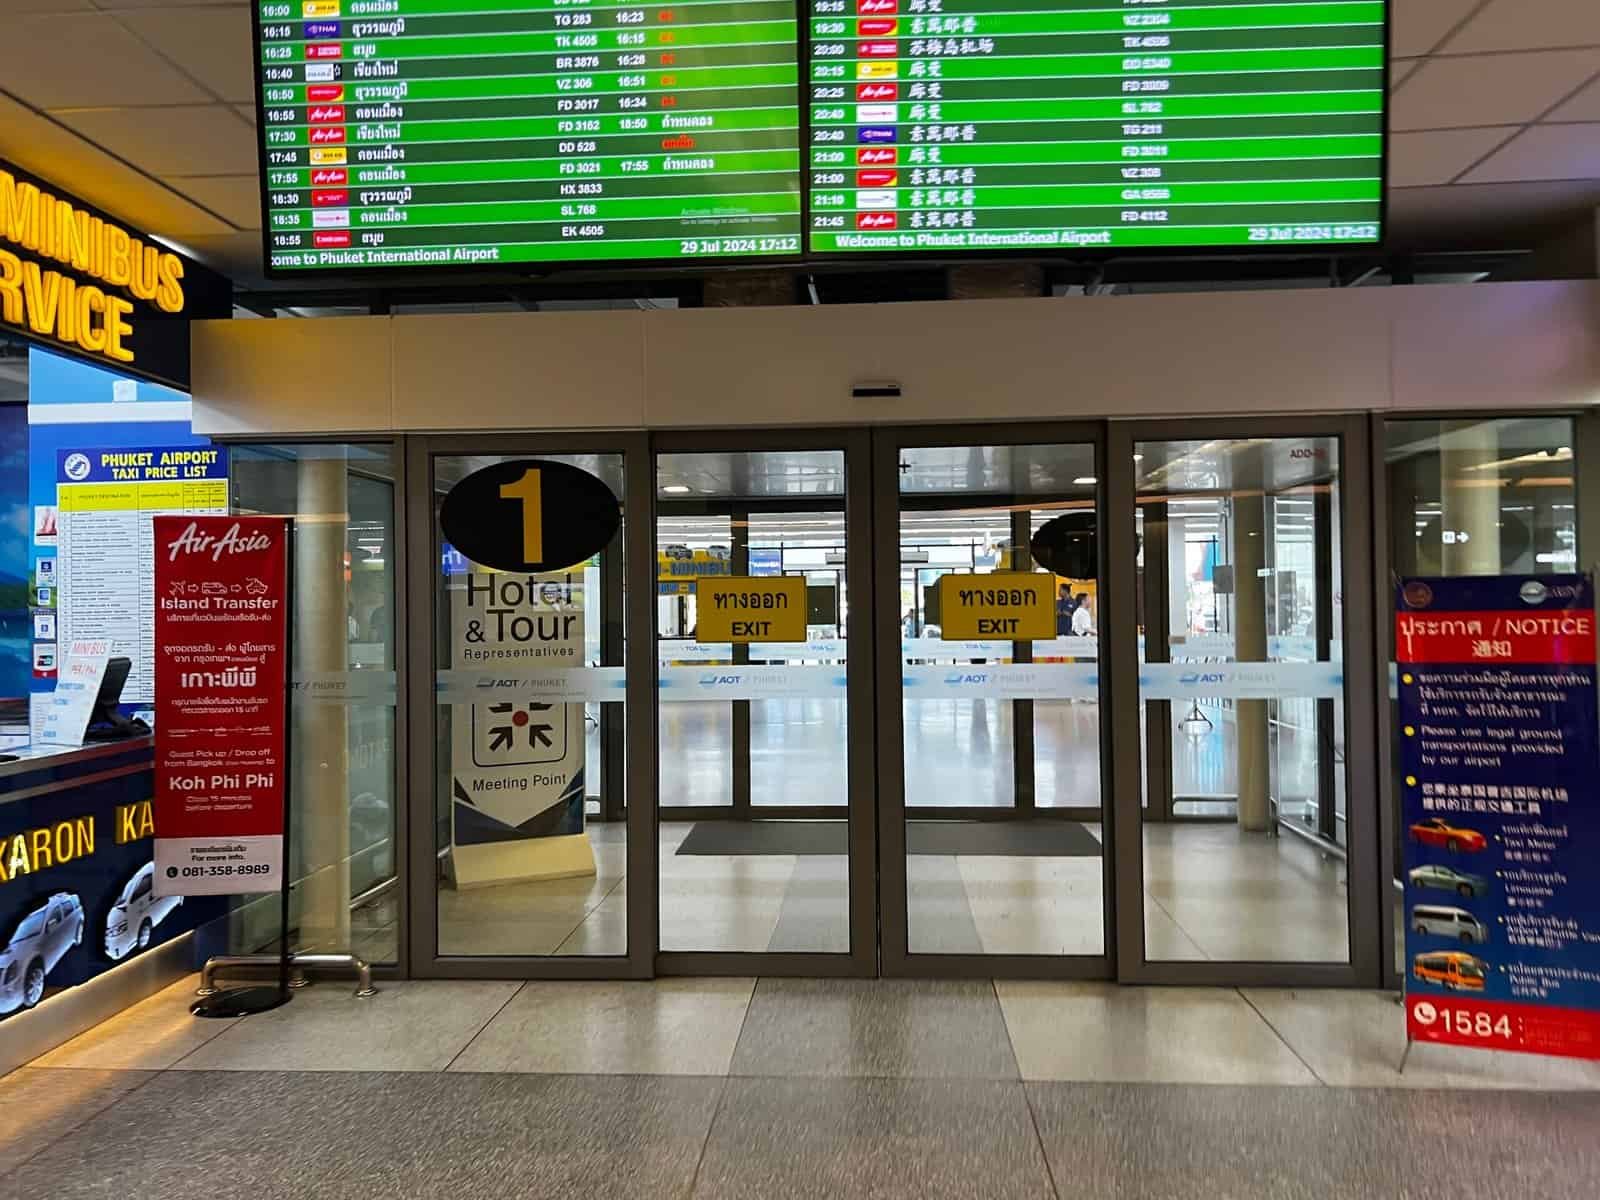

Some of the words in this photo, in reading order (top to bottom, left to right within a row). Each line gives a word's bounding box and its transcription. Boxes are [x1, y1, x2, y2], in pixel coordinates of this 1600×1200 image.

[556, 36, 570, 46] TK
[266, 68, 292, 79] 16:40
[557, 58, 572, 68] BR
[557, 79, 571, 89] VZ
[558, 100, 575, 110] FD
[269, 131, 295, 141] 17:30
[558, 121, 573, 131] FD
[270, 152, 296, 162] 17:45
[559, 142, 575, 152] DD
[272, 173, 298, 183] 17:55
[560, 163, 577, 173] FD
[621, 161, 648, 171] 17:55
[561, 184, 576, 194] HX
[561, 206, 576, 215] SL
[562, 227, 577, 236] EK
[835, 234, 898, 247] Welcome
[900, 235, 915, 246] to
[917, 233, 965, 246] Phuket
[968, 231, 1059, 245] International
[1061, 231, 1111, 245] Airport
[0, 169, 184, 312] MINIBUS
[680, 241, 698, 254] 29
[700, 240, 720, 253] Jul
[722, 239, 757, 252] 2024
[759, 238, 798, 251] 17:12
[303, 252, 317, 265] to
[320, 251, 364, 265] Phuket
[367, 248, 450, 263] International
[453, 247, 499, 261] Airport
[101, 452, 153, 467] PHUKET
[160, 450, 217, 464] AIRPORT
[112, 468, 139, 480] TAXI
[145, 467, 178, 478] PRICE
[184, 466, 207, 477] LIST
[500, 468, 543, 564] 1
[168, 521, 271, 561] AirAsia
[467, 573, 572, 606] Hotel
[161, 597, 209, 609] Island
[213, 597, 278, 609] Transfer
[714, 592, 788, 609] ทางออก
[959, 589, 1037, 606] ทางออก
[465, 620, 486, 642] &
[486, 609, 576, 642] Tour
[732, 621, 772, 636] EXIT
[978, 619, 1020, 634] EXIT
[1400, 615, 1482, 635] ประกาศ
[1506, 618, 1590, 635] NOTICE
[464, 647, 574, 660] Representatives
[181, 666, 257, 688] เกาะพีพี
[495, 679, 520, 688] AOT
[718, 675, 742, 684] AOT
[964, 674, 988, 683] AOT
[1200, 673, 1224, 683] AOT
[1421, 725, 1457, 736] Please
[1519, 728, 1563, 740] ground
[195, 749, 214, 758] Pick
[215, 750, 226, 759] up
[235, 749, 256, 758] Drop
[258, 748, 270, 756] off
[1511, 742, 1564, 755] provided
[164, 759, 185, 767] from
[187, 759, 223, 768] Bangkok
[1421, 755, 1436, 766] by
[1440, 757, 1459, 766] our
[1464, 756, 1501, 767] airport
[169, 776, 206, 790] Koh
[211, 774, 239, 789] Phi
[245, 773, 273, 788] Phi
[472, 777, 528, 792] Meeting
[533, 774, 567, 786] Point
[0, 815, 95, 883] KARON
[182, 864, 270, 877] 081-358-8989
[1439, 1007, 1512, 1039] 1584
